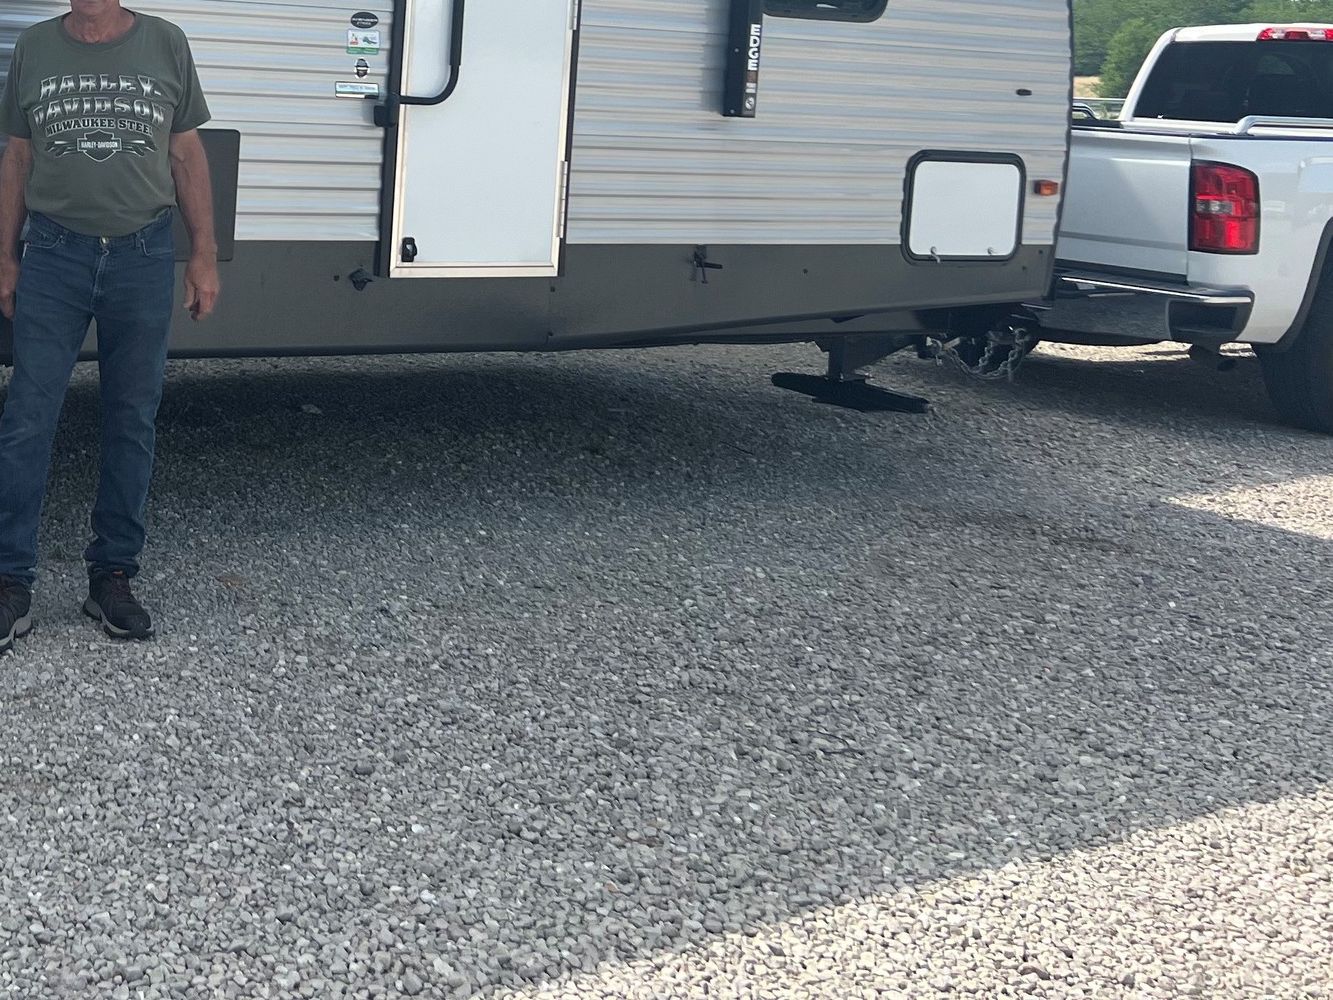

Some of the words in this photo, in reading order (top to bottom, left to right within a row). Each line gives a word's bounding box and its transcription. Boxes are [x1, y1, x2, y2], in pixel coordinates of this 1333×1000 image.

[747, 23, 762, 71] EDGE
[39, 74, 162, 101] HARLEY-
[32, 96, 166, 129] DAVIDSON
[45, 117, 115, 137] MILWAUKEE
[118, 118, 153, 137] STEEL
